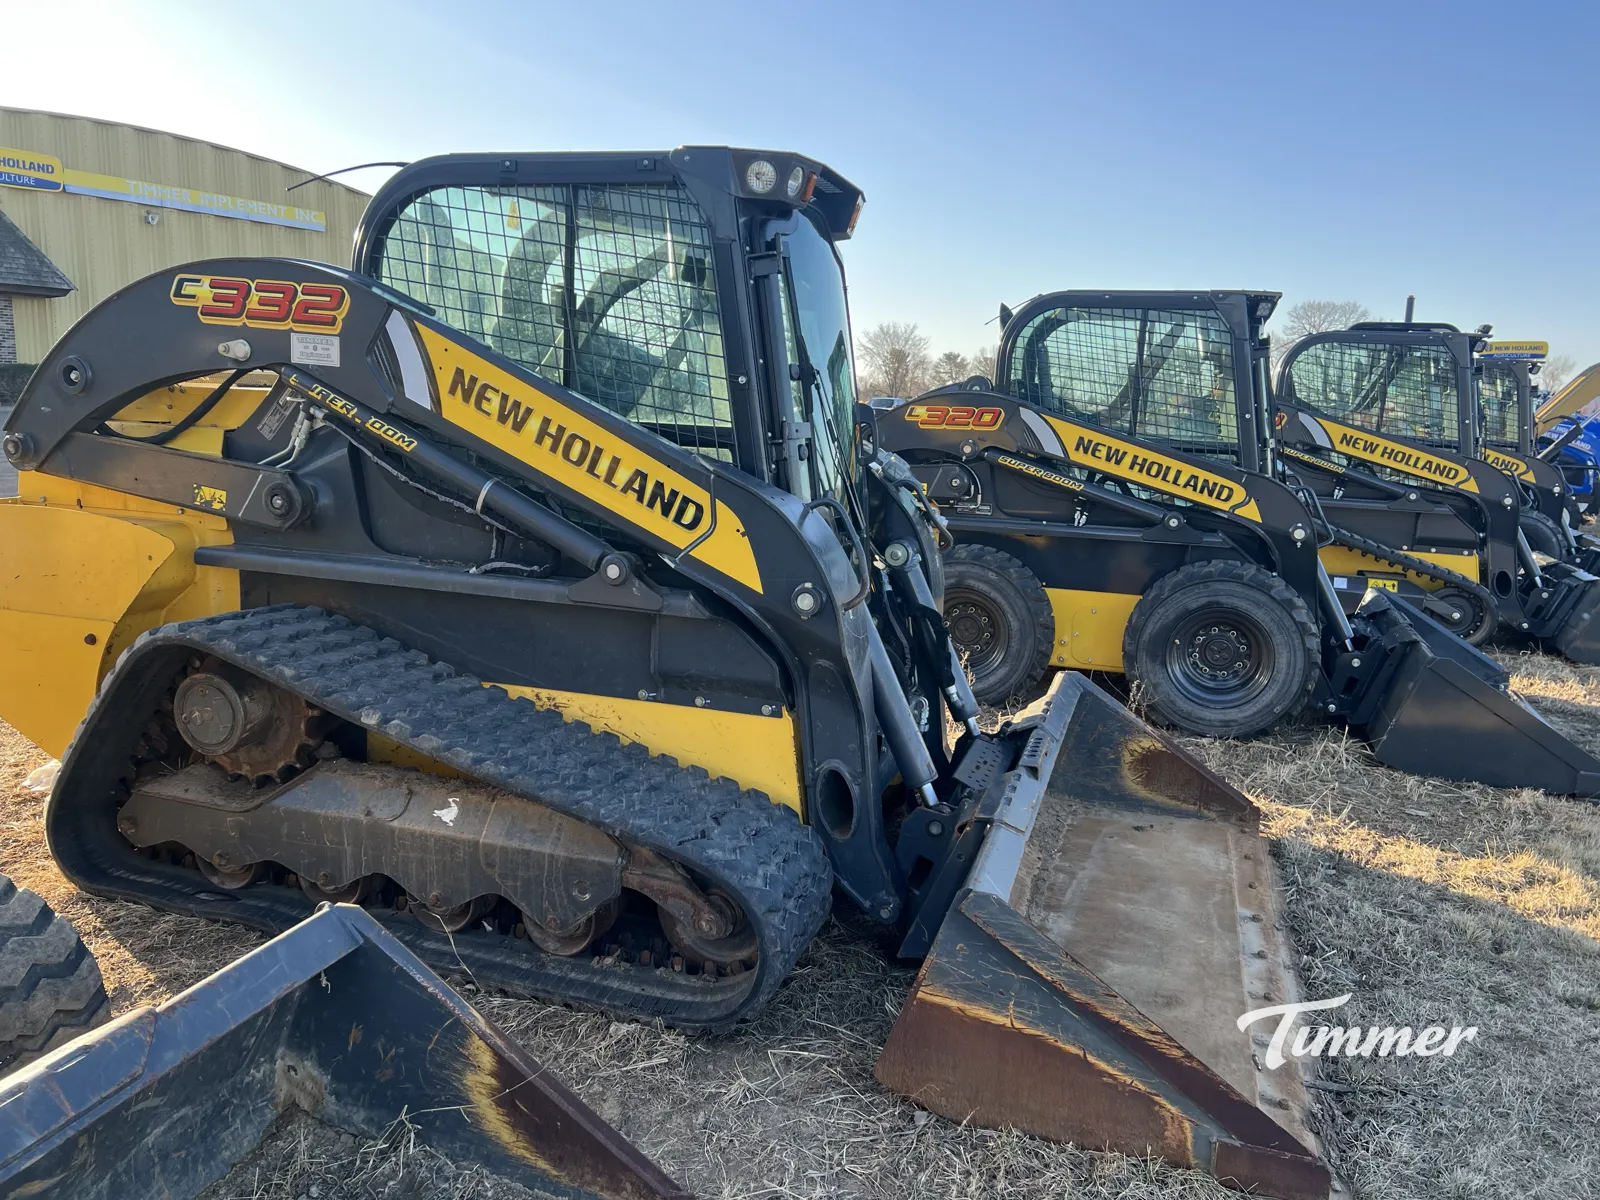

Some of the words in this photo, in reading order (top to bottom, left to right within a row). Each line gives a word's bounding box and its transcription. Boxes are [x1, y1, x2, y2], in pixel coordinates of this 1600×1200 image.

[126, 180, 190, 202] TIMMER
[201, 193, 287, 218] IMPLEMENT
[294, 207, 325, 225] INC.
[904, 405, 1005, 431] L320
[447, 366, 534, 435] NEW
[533, 415, 705, 532] HOLLAND
[1074, 435, 1126, 466] NEW
[1129, 454, 1235, 503] HOLLAND
[1339, 432, 1380, 455] NEW
[1379, 446, 1460, 481] HOLLAND
[998, 455, 1044, 478] SUPER
[1042, 471, 1085, 492] BOOM
